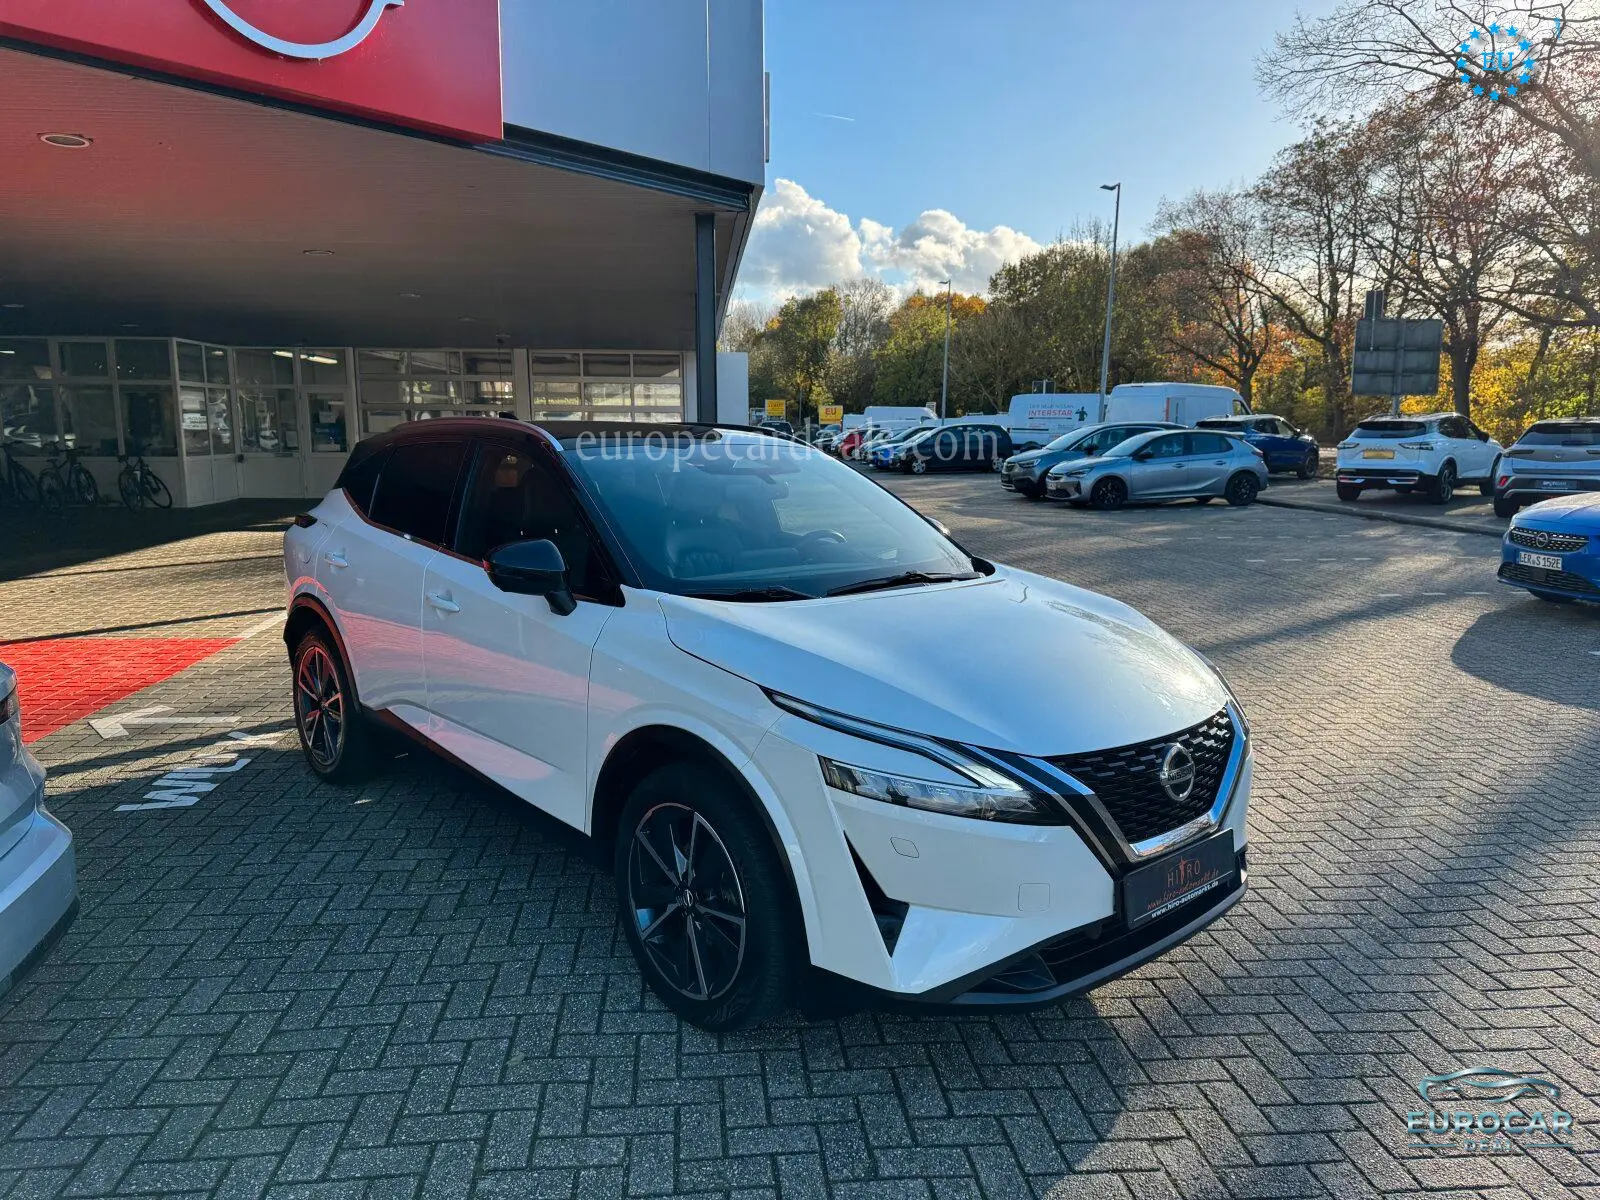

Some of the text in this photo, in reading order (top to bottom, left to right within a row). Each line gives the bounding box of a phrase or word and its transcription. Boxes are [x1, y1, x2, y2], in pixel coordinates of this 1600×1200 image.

[824, 407, 837, 416] EU
[1028, 409, 1073, 417] INTERSTAR
[1151, 880, 1220, 919] www.hiro-automarkt.de
